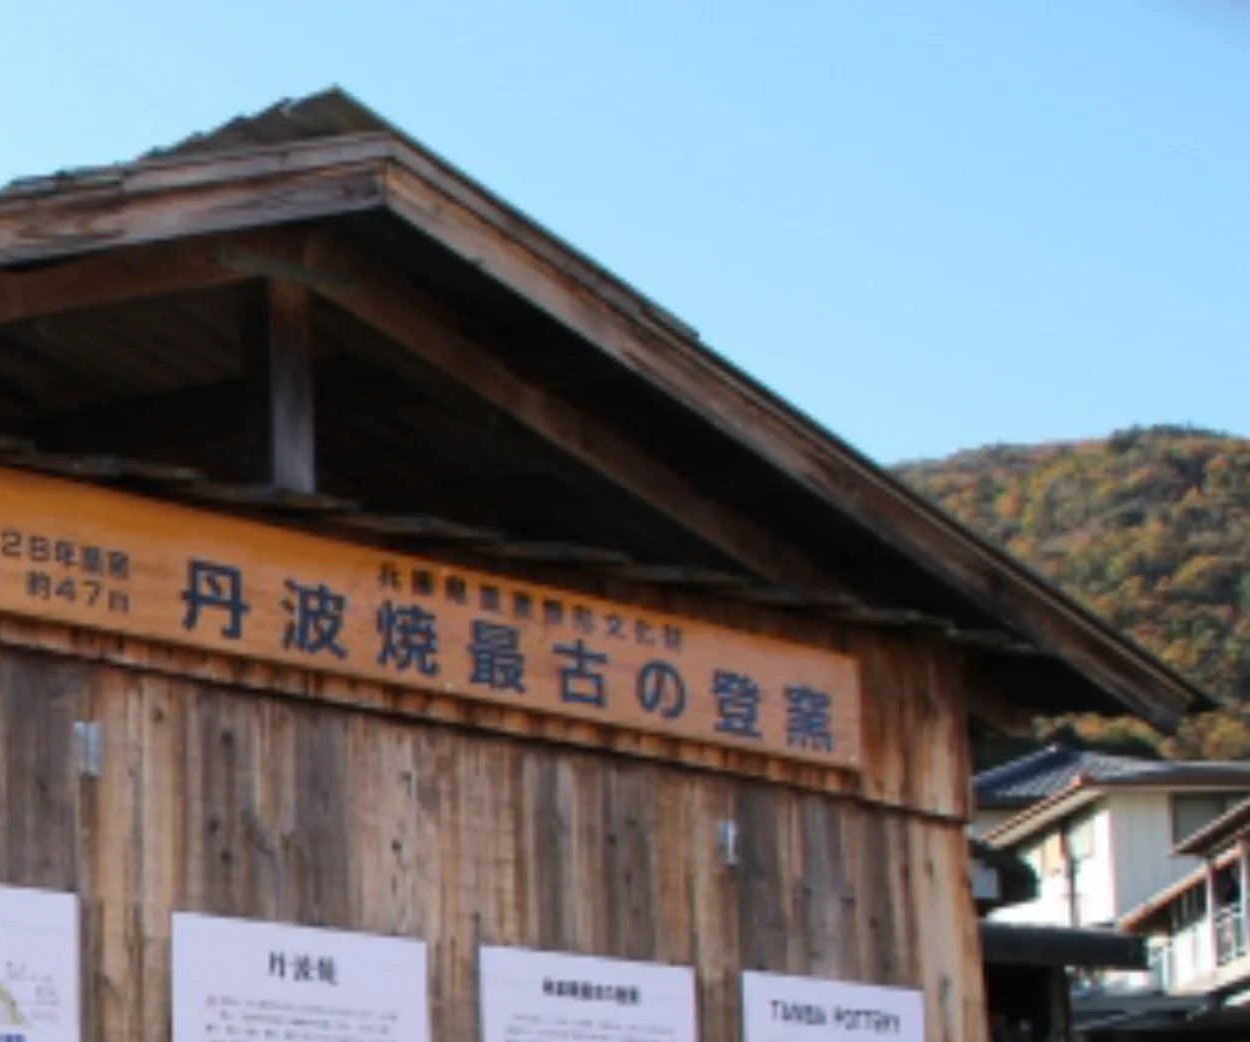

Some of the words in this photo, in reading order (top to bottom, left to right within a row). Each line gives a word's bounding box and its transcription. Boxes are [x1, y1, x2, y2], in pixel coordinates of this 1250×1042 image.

[181, 560, 834, 752] 丹波焼最古の登窯
